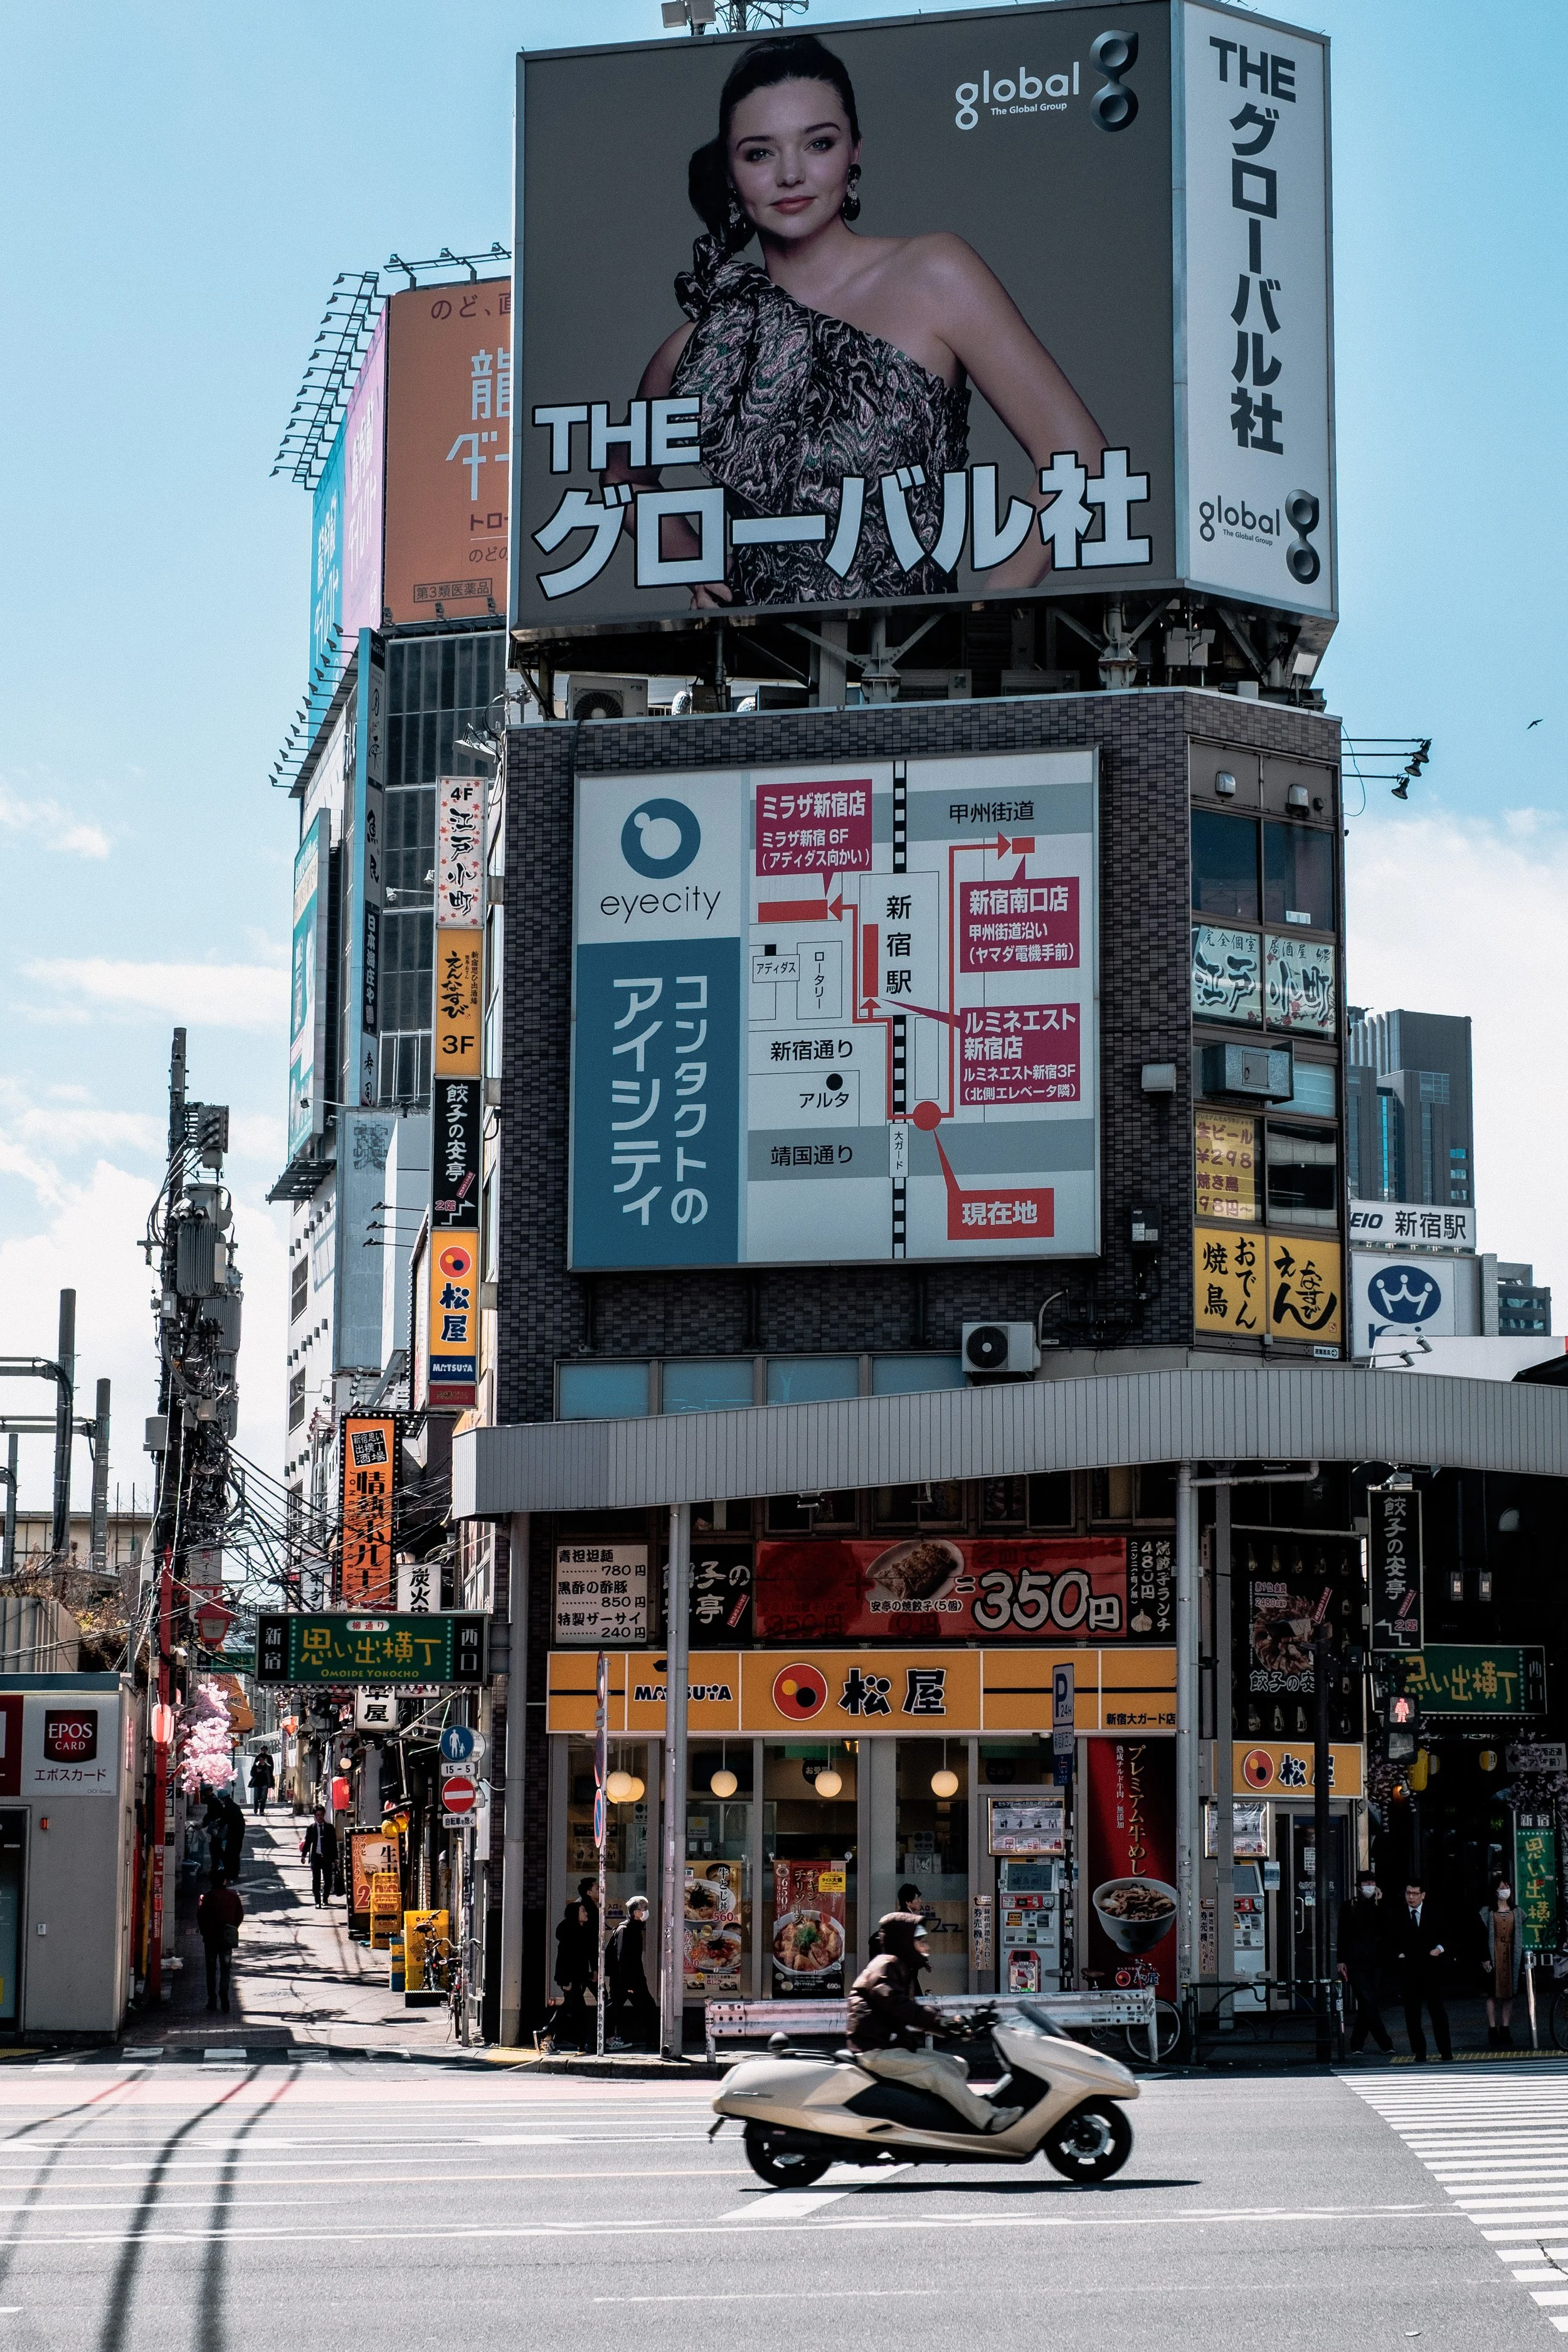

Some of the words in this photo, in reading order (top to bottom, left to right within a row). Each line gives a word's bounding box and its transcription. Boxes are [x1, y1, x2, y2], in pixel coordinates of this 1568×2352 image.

[1209, 36, 1296, 103] THE
[955, 61, 1080, 130] global
[991, 107, 1007, 115] The
[1009, 104, 1039, 115] Global
[1041, 101, 1067, 114] Group
[1230, 103, 1284, 456] グローバル社
[534, 397, 702, 474] THE
[534, 447, 1151, 600] グローバル社
[1199, 494, 1281, 542] global
[1234, 530, 1253, 542] Global
[1254, 534, 1273, 547] Group
[416, 583, 490, 600] 第3類医薬品
[450, 787, 474, 802] 4F
[763, 790, 866, 820] ミラザ新宿店
[949, 800, 1035, 824] 甲州街道
[763, 830, 825, 849] ミラザ新宿
[829, 829, 849, 845] 6F
[448, 808, 477, 916] 江戸小町
[762, 848, 871, 869] (アディダス向かい)
[600, 886, 721, 923] eyecity
[969, 886, 1069, 916] 新宿南口店
[968, 923, 1048, 941] 甲州街道沿い
[886, 895, 913, 995] 新宿駅
[968, 943, 1075, 965] (ヤマダ電機手前)
[1268, 936, 1306, 960] 居酒屋
[756, 960, 797, 976] アディダス
[440, 950, 469, 1019] えんなすび
[814, 951, 825, 1010] ロータリー
[964, 1010, 1076, 1036] ルミネエスト
[442, 1036, 475, 1055] 3F
[770, 1039, 854, 1062] 新宿通り
[964, 1036, 1023, 1061] 新宿店
[963, 1064, 1076, 1083] ルミネエスト新宿3F
[612, 977, 663, 1227] アイシティ
[671, 975, 708, 1226] コンタクトの
[799, 1092, 850, 1108] アルタ
[964, 1084, 1076, 1102] (北側エレベータ隣)
[445, 1083, 469, 1183] 餃子の安亭
[1197, 1121, 1253, 1145] 生ビール
[770, 1144, 854, 1167] 靖国通り
[894, 1131, 904, 1170] 大ガード
[1197, 1147, 1252, 1169] ¥298
[1197, 1172, 1239, 1192] 焼き鳥
[962, 1199, 1038, 1226] 現在地
[1395, 1210, 1466, 1239] 新宿駅
[1203, 1242, 1228, 1317] 焼鳥
[1234, 1237, 1256, 1330] おでん
[438, 1283, 470, 1343] 松屋
[433, 1364, 473, 1372] MATSUYA
[1383, 1496, 1406, 1601] 餃子の安亭
[601, 1564, 647, 1577] 780円
[1141, 1541, 1155, 1599] 480円
[558, 1581, 628, 1595] 黒酢の酢豚
[1155, 1540, 1171, 1632] 焼餃子ランチ
[601, 1596, 647, 1608] 850円
[871, 1599, 963, 1613] 安亭の焼餃子(5個)
[973, 1569, 1122, 1631] 350円
[557, 1612, 642, 1627] 特製ザーサイ
[601, 1627, 647, 1639] 240円
[265, 1628, 282, 1670] 新宿
[300, 1628, 442, 1666] 思い出横丁
[460, 1628, 478, 1671] 西口
[320, 1668, 364, 1678] OMOIDE
[367, 1668, 420, 1678] YOKOCHO
[838, 1668, 946, 1717] 松屋
[1056, 1673, 1067, 1718] P
[1061, 1704, 1073, 1717] 24H
[1106, 1713, 1176, 1725] 新宿大ガード店
[48, 1723, 93, 1739] EPOS
[55, 1741, 86, 1750] CARD
[34, 1769, 107, 1782] エポスカード
[445, 1817, 474, 1826] 自転車を除く
[1128, 1744, 1147, 1876] プレミアム牛めし
[1520, 1814, 1550, 1827] 新宿
[717, 1867, 729, 1912] 牛とじ丼
[1525, 1837, 1551, 1943] 思い出横丁
